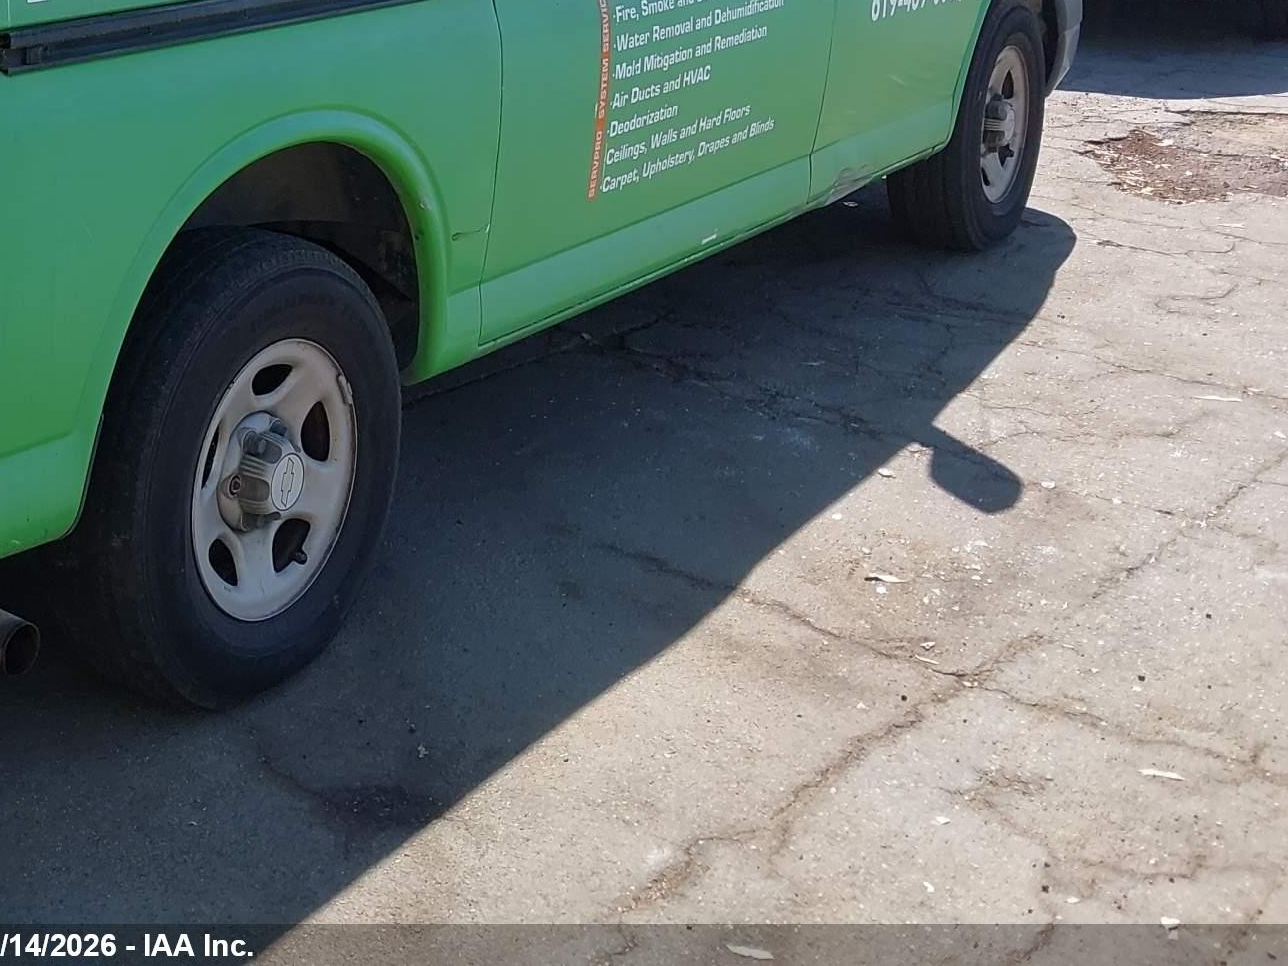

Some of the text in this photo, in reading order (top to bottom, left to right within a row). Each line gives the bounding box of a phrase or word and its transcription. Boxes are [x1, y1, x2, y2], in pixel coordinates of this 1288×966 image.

[615, 25, 768, 79] Mold Mitigation and Remediation
[616, 32, 650, 52] Water
[653, 17, 694, 42] Removal
[695, 12, 713, 31] and
[598, 57, 610, 119] SYSTEM
[612, 65, 712, 109] Air Ducts and HVAC
[606, 104, 751, 165] Ceilings, Walls and Hard Floors
[609, 104, 679, 137] Deodorization
[697, 135, 730, 157] Drapes
[731, 129, 748, 144] and
[749, 116, 775, 138] Blinds
